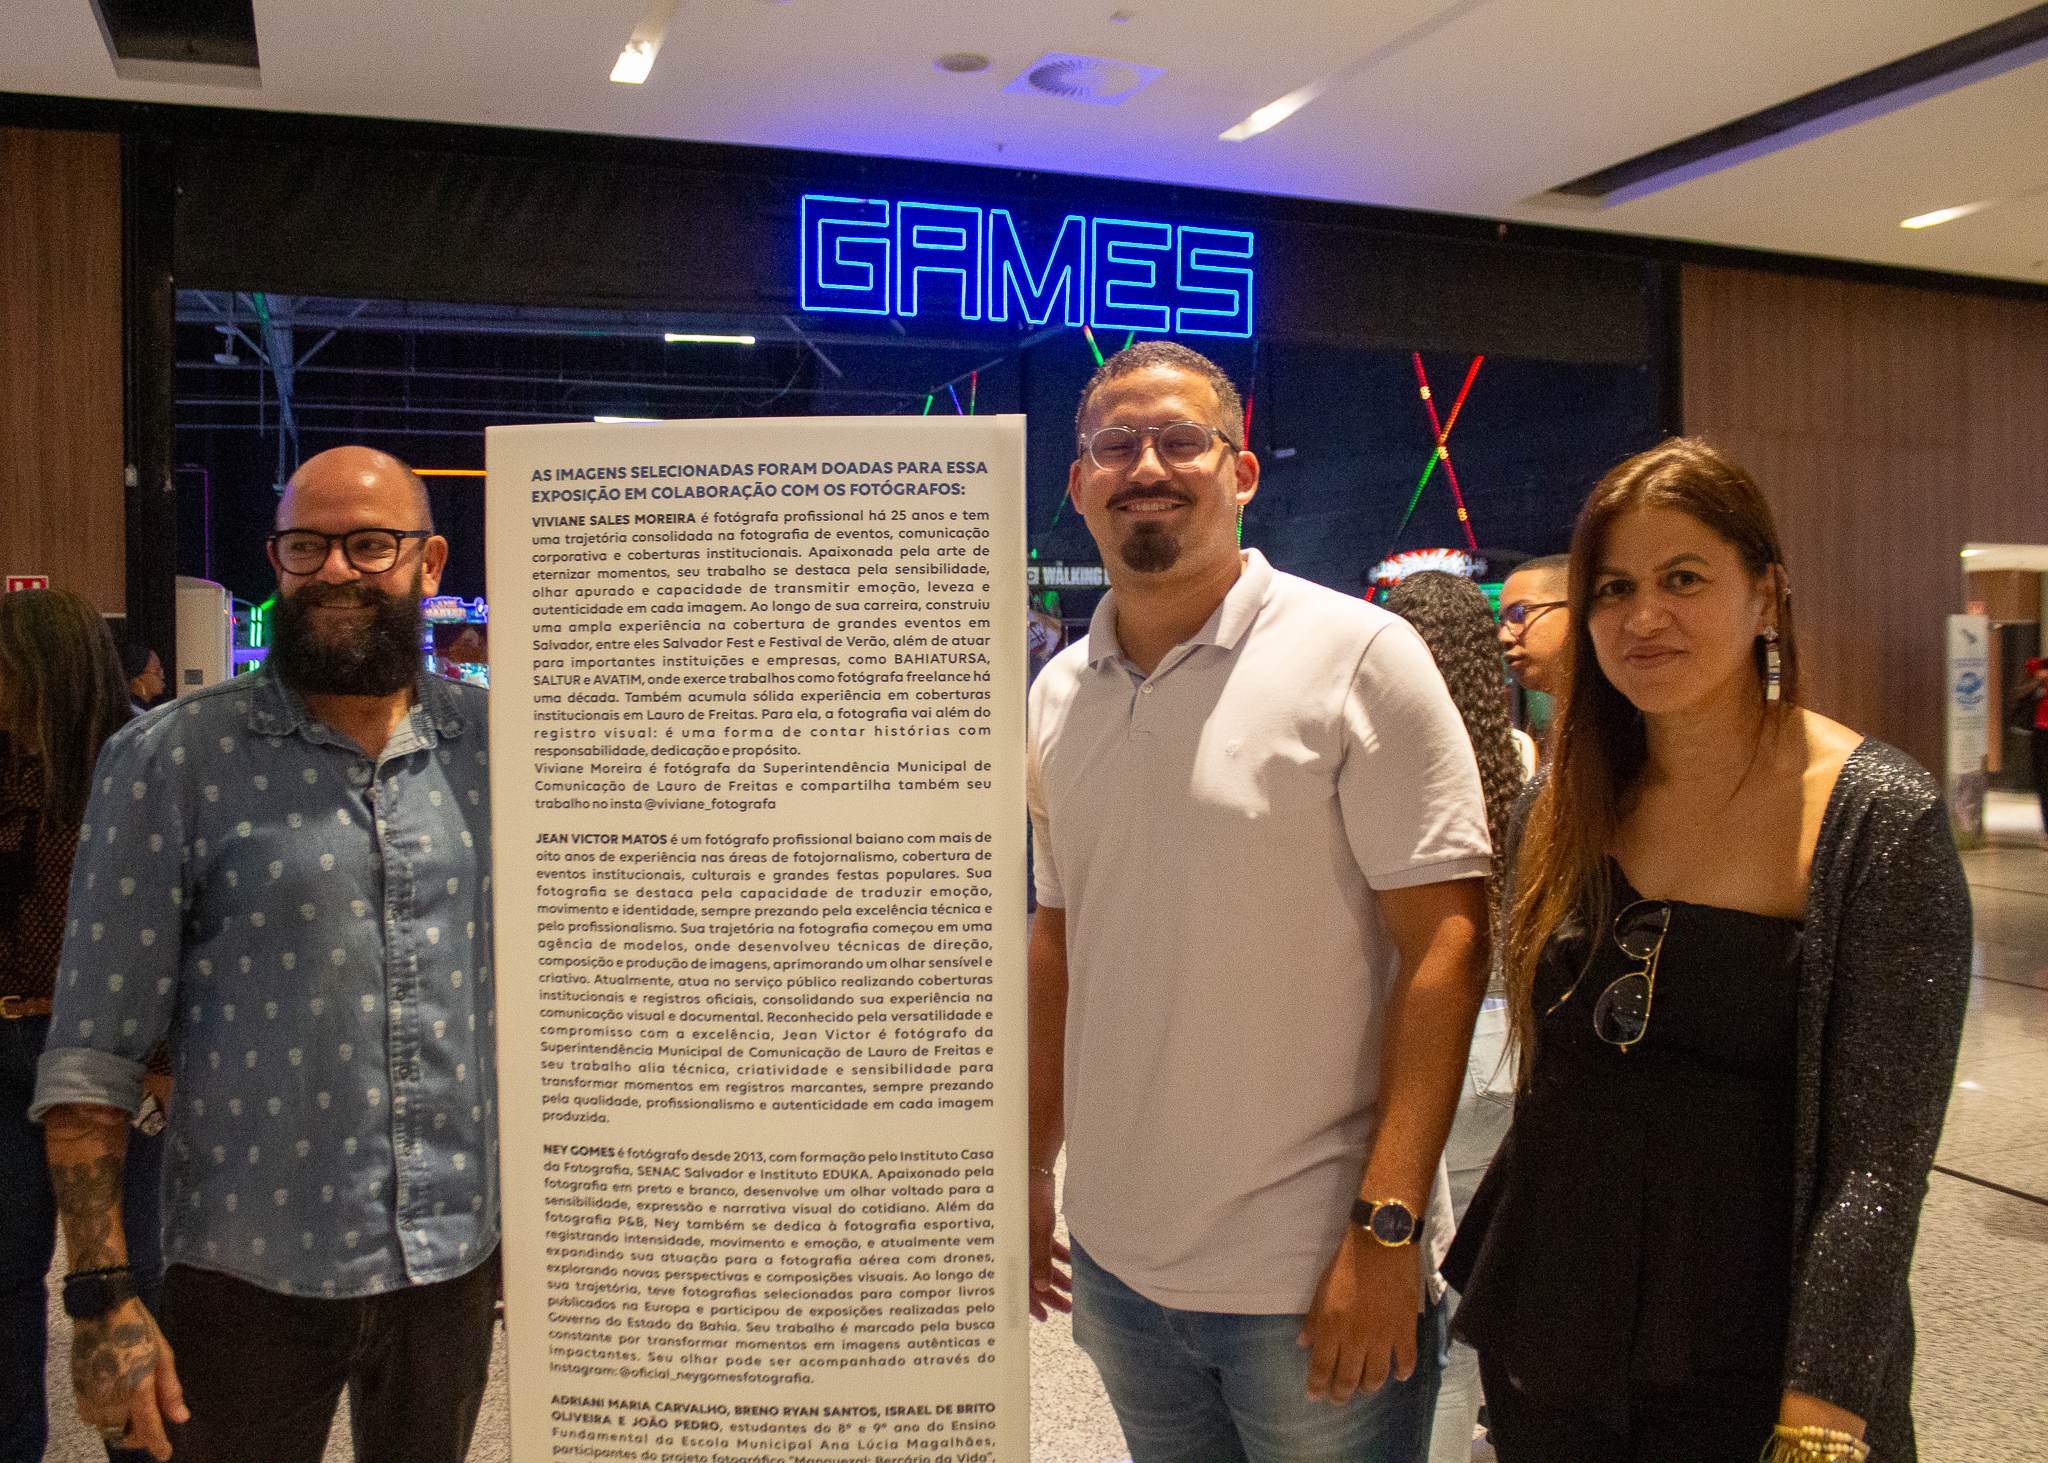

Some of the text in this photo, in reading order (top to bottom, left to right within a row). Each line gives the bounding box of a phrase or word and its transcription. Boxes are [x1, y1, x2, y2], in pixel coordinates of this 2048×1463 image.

[800, 194, 1254, 338] GAMES
[531, 461, 988, 482] AS IMAGENS SELECIONADAS FORAM DOADAS PARA ESSA
[532, 479, 965, 504] EXPOSIÇÃO EM COLABORAÇÃO COM OS FOTÓGRAFOS:
[532, 510, 989, 528] VIVIANE SALES MOREIRA é fotógrafa profissional há 25 anos e tem
[532, 527, 990, 547] uma trajetória consolidada na fotografia de eventos, comunicação
[532, 545, 990, 565] corporativa e coberturas institucionais. Apaixonada pela arte de
[1043, 566, 1104, 585] WALKING
[532, 581, 990, 599] olhar apurado e capacidade de transmitir emoção, leveza e
[533, 653, 990, 671] para importantes instituições e empresas, como BAHIATURSA,
[533, 689, 991, 704] uma década. Também acumula sólida experiência em coberturas
[534, 760, 992, 777] Viviane Moreira é fotógrafa da Superintendência Municipal de
[535, 831, 992, 848] JEAN VICTOR MATOS é um fotógrafo profissional baiano com mais de
[536, 884, 992, 901] fotografia se destaca pela capacidade de traduzir emoção,
[537, 938, 993, 952] agência de modelos, onde desenvolveu técnicas de direção,
[540, 1026, 993, 1041] compromisso com a excelência, Jean Victor é fotógrafo da
[542, 1093, 994, 1111] pela qualidade, profissionalismo e autenticidade em cada imagem
[543, 1161, 560, 1172] da
[637, 1165, 680, 1177] SENAC
[684, 1167, 744, 1179] Salvador
[748, 1171, 756, 1179] e
[760, 1169, 818, 1180] Instituto
[877, 1167, 961, 1181] Apaixonado
[964, 1166, 994, 1179] pela
[545, 1211, 611, 1226] fotografia
[654, 1218, 680, 1231] Ney
[686, 1220, 745, 1230] também
[752, 1222, 767, 1231] se
[774, 1221, 821, 1231] dedica
[844, 1219, 916, 1234] fotografia
[551, 1394, 604, 1408] ADRIANI
[608, 1399, 651, 1411] MARIA
[734, 1405, 779, 1416] BRENO
[783, 1406, 819, 1417] RYAN
[885, 1405, 932, 1417] ISRAEL
[935, 1404, 953, 1415] DE
[956, 1402, 996, 1414] BRITO
